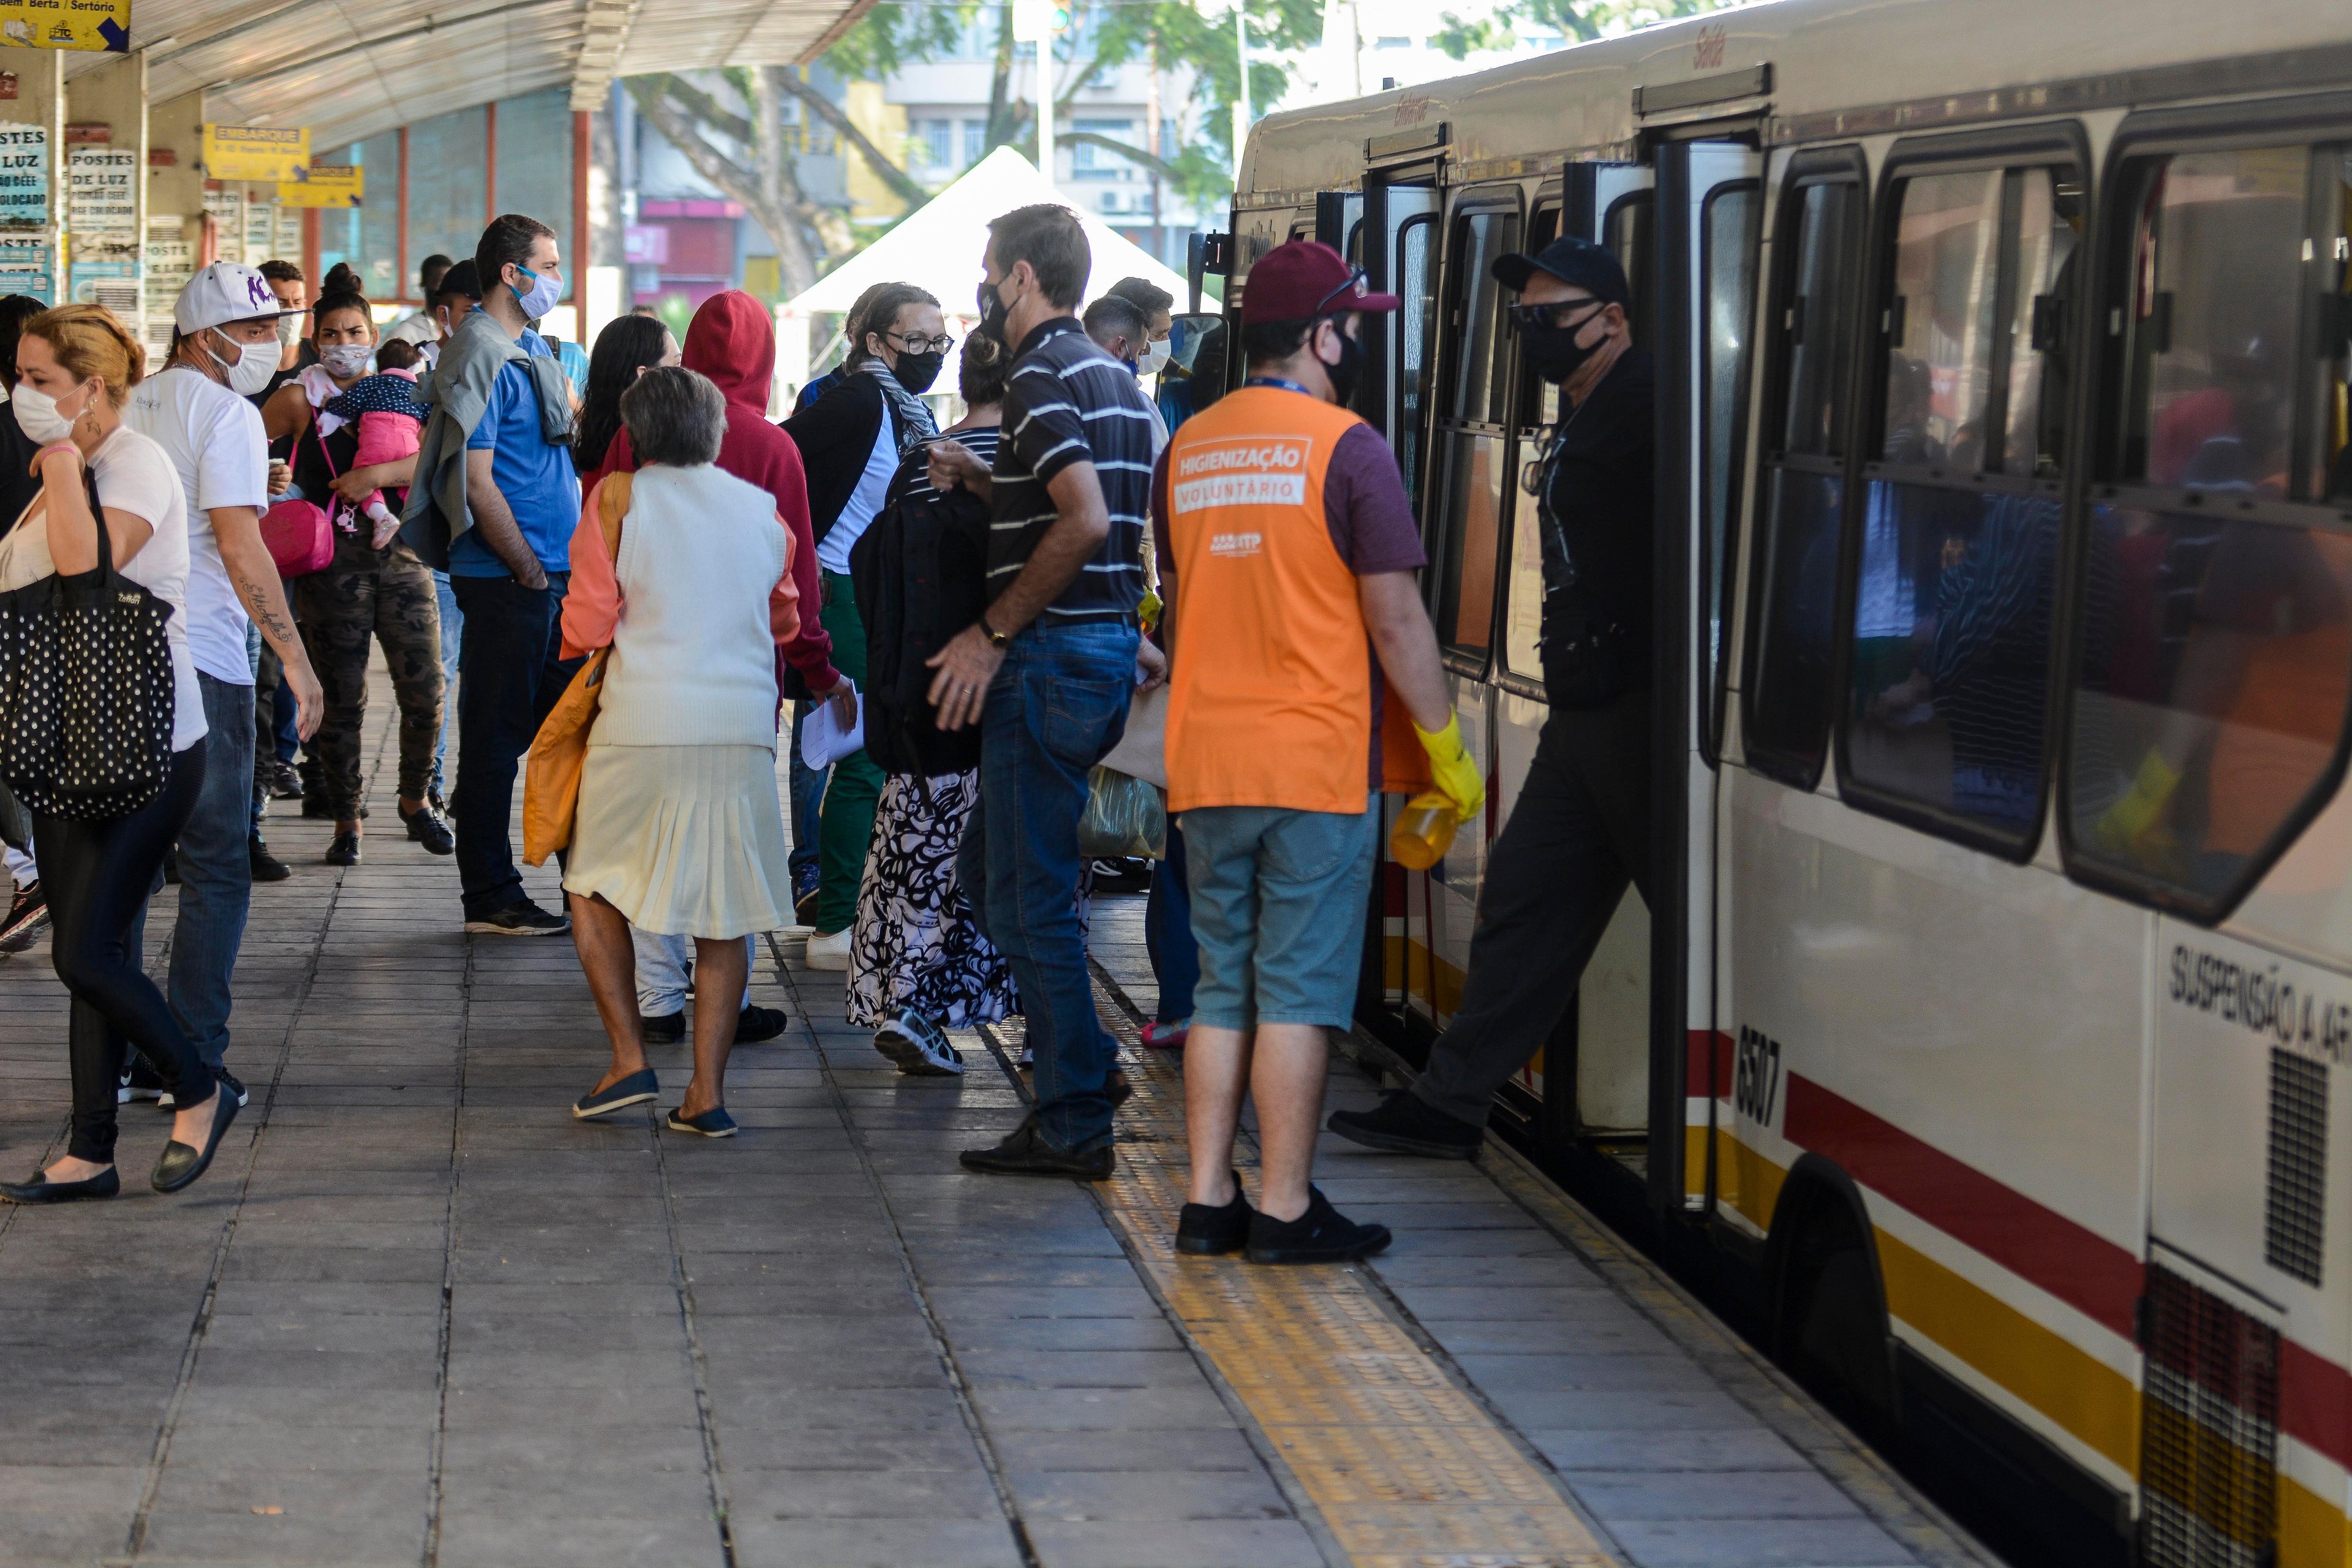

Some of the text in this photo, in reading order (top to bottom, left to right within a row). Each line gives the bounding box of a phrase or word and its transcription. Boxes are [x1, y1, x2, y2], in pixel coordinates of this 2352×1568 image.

[29, 0, 59, 9] Berta
[71, 0, 115, 12] Sertório
[1393, 91, 1430, 127] Embarque
[218, 127, 300, 141] EMBARQUE
[3, 155, 39, 168] LUZ
[72, 156, 132, 166] POSTES
[13, 176, 37, 186] CEEE
[72, 175, 127, 185] DE LUZ
[0, 194, 45, 205] OLOCADO
[1180, 445, 1300, 477] HIGIENIZAÇÃO
[1182, 481, 1292, 504] VOLUNTÁRIO
[2171, 944, 2297, 1042] SUSPENSÃO
[2301, 992, 2315, 1042] A
[1737, 1024, 1780, 1127] 6507
